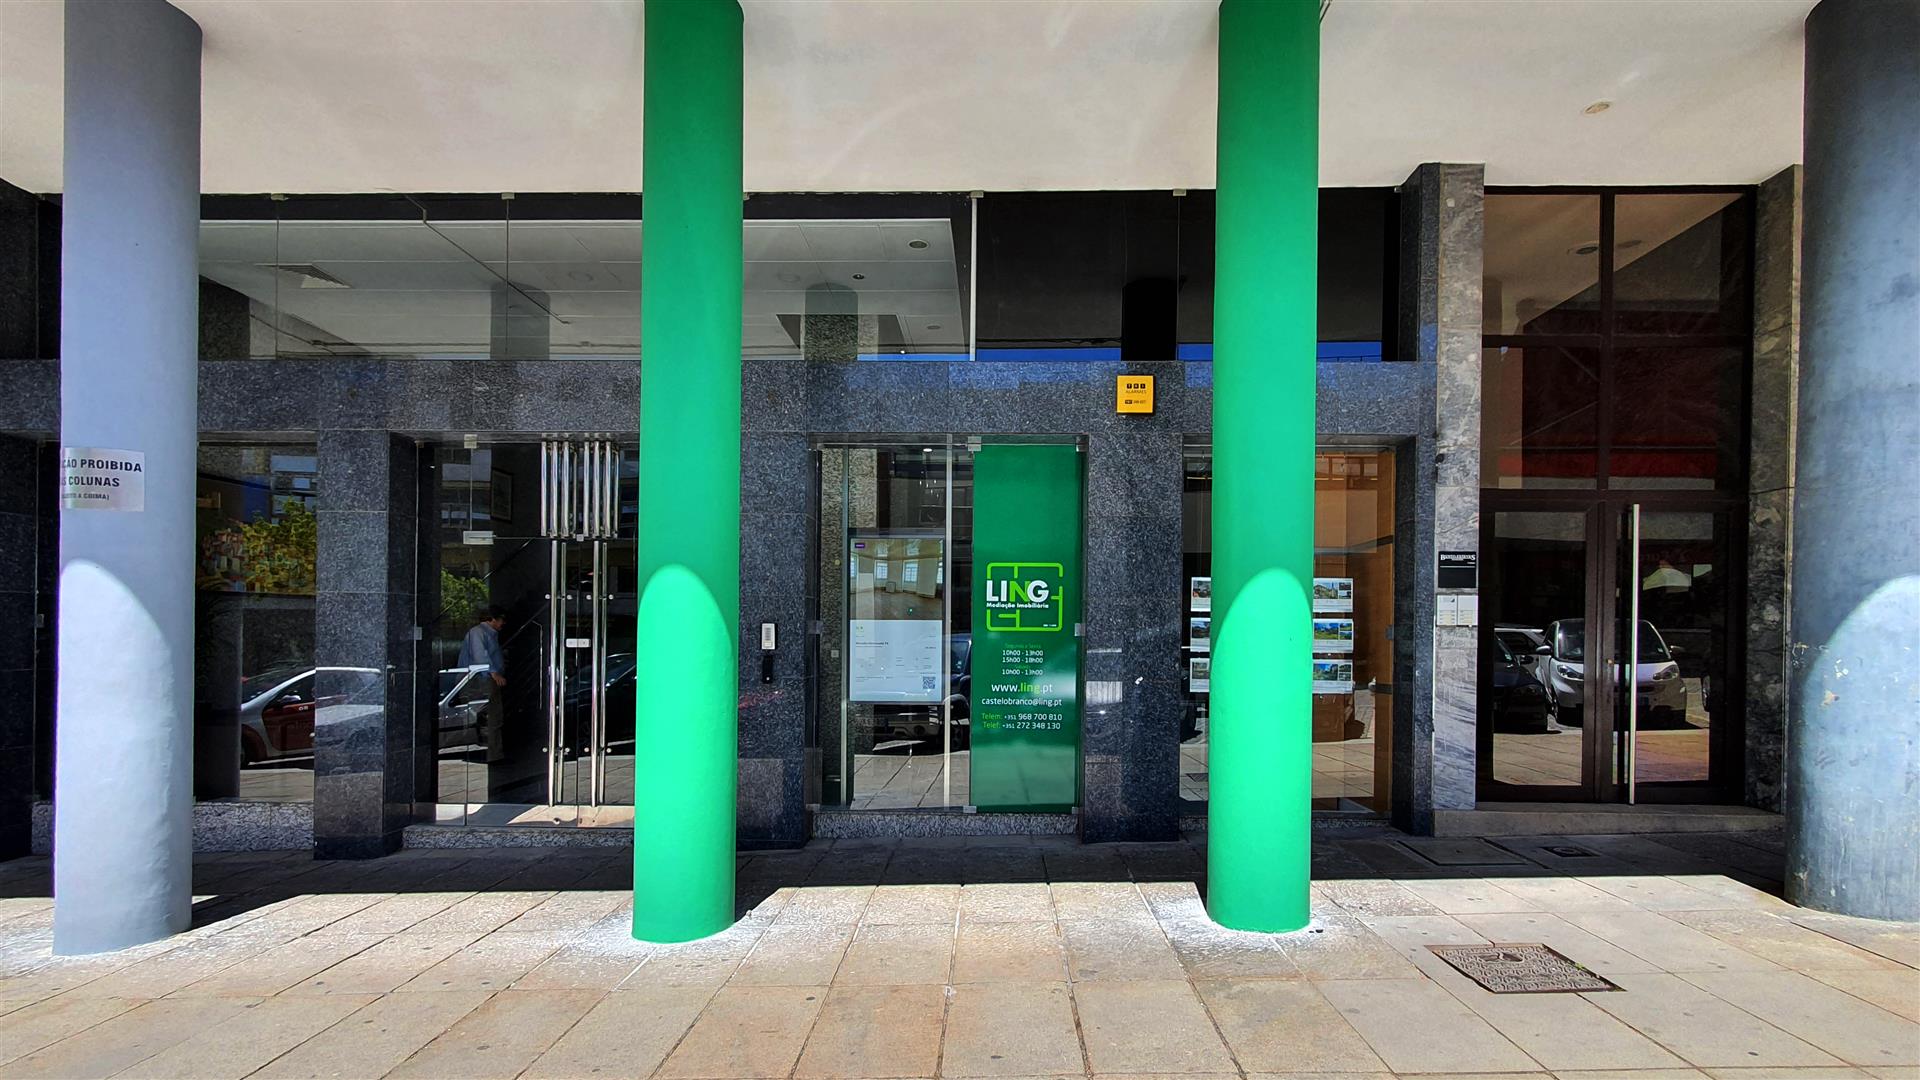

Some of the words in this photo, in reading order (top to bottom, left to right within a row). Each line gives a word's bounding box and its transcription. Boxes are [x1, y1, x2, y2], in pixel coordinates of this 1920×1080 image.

[80, 459, 142, 472] PROIBIDA
[68, 476, 120, 488] COLUNAS
[986, 580, 1050, 603] LING
[992, 682, 1053, 694] www.ling.pt
[982, 698, 1062, 707] castelobranco@ling.pt
